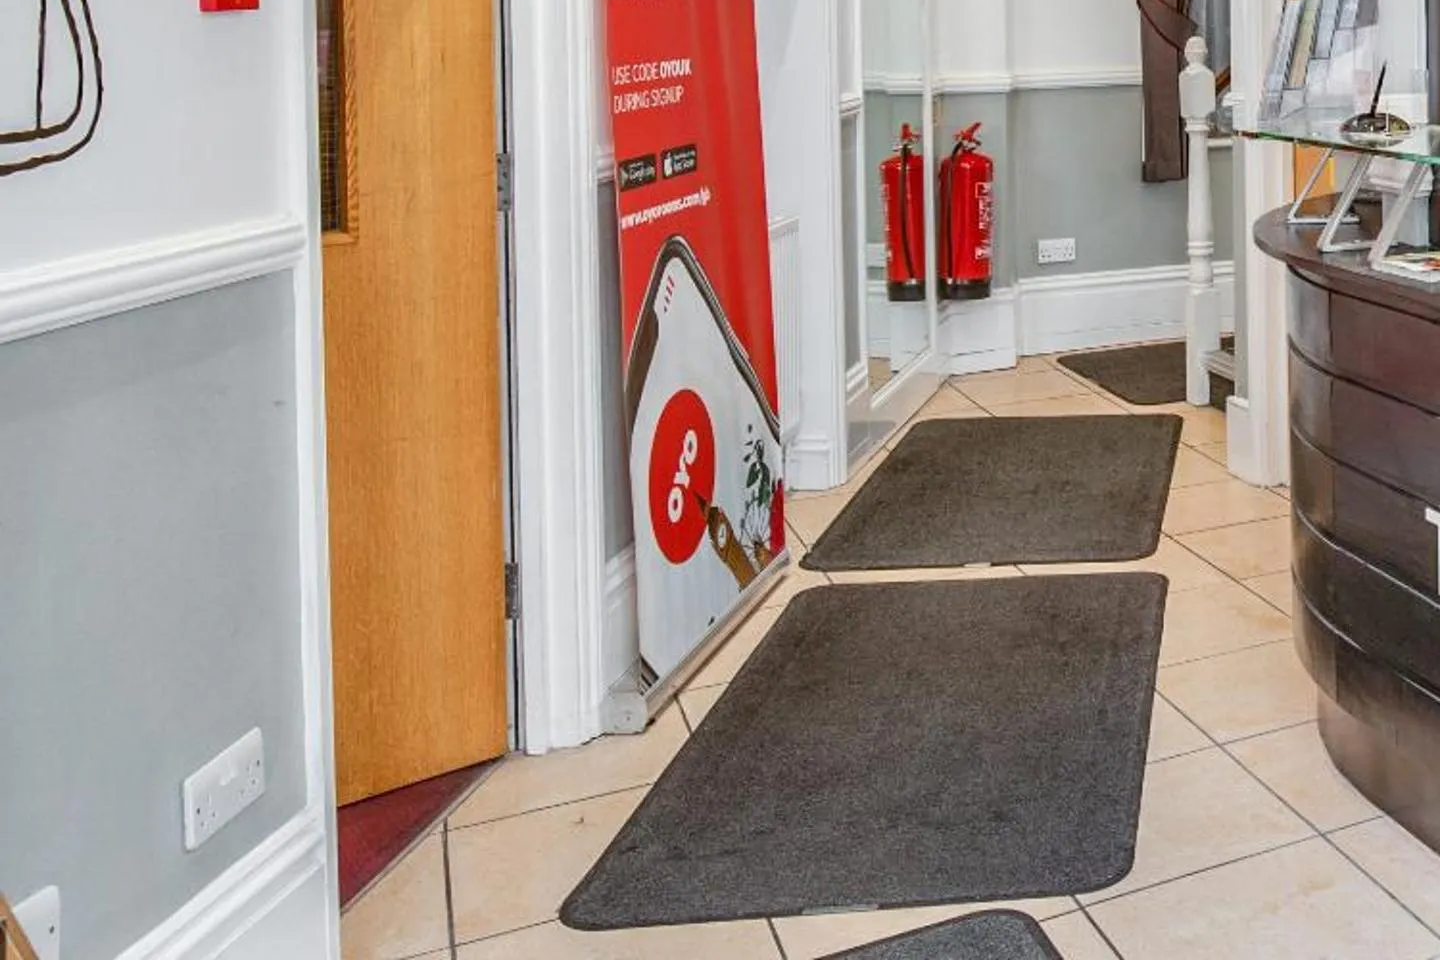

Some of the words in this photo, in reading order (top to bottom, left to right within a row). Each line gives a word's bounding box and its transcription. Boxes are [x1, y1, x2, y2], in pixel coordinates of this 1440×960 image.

[611, 64, 631, 86] USE
[631, 61, 659, 83] CODE
[613, 89, 650, 115] DURING
